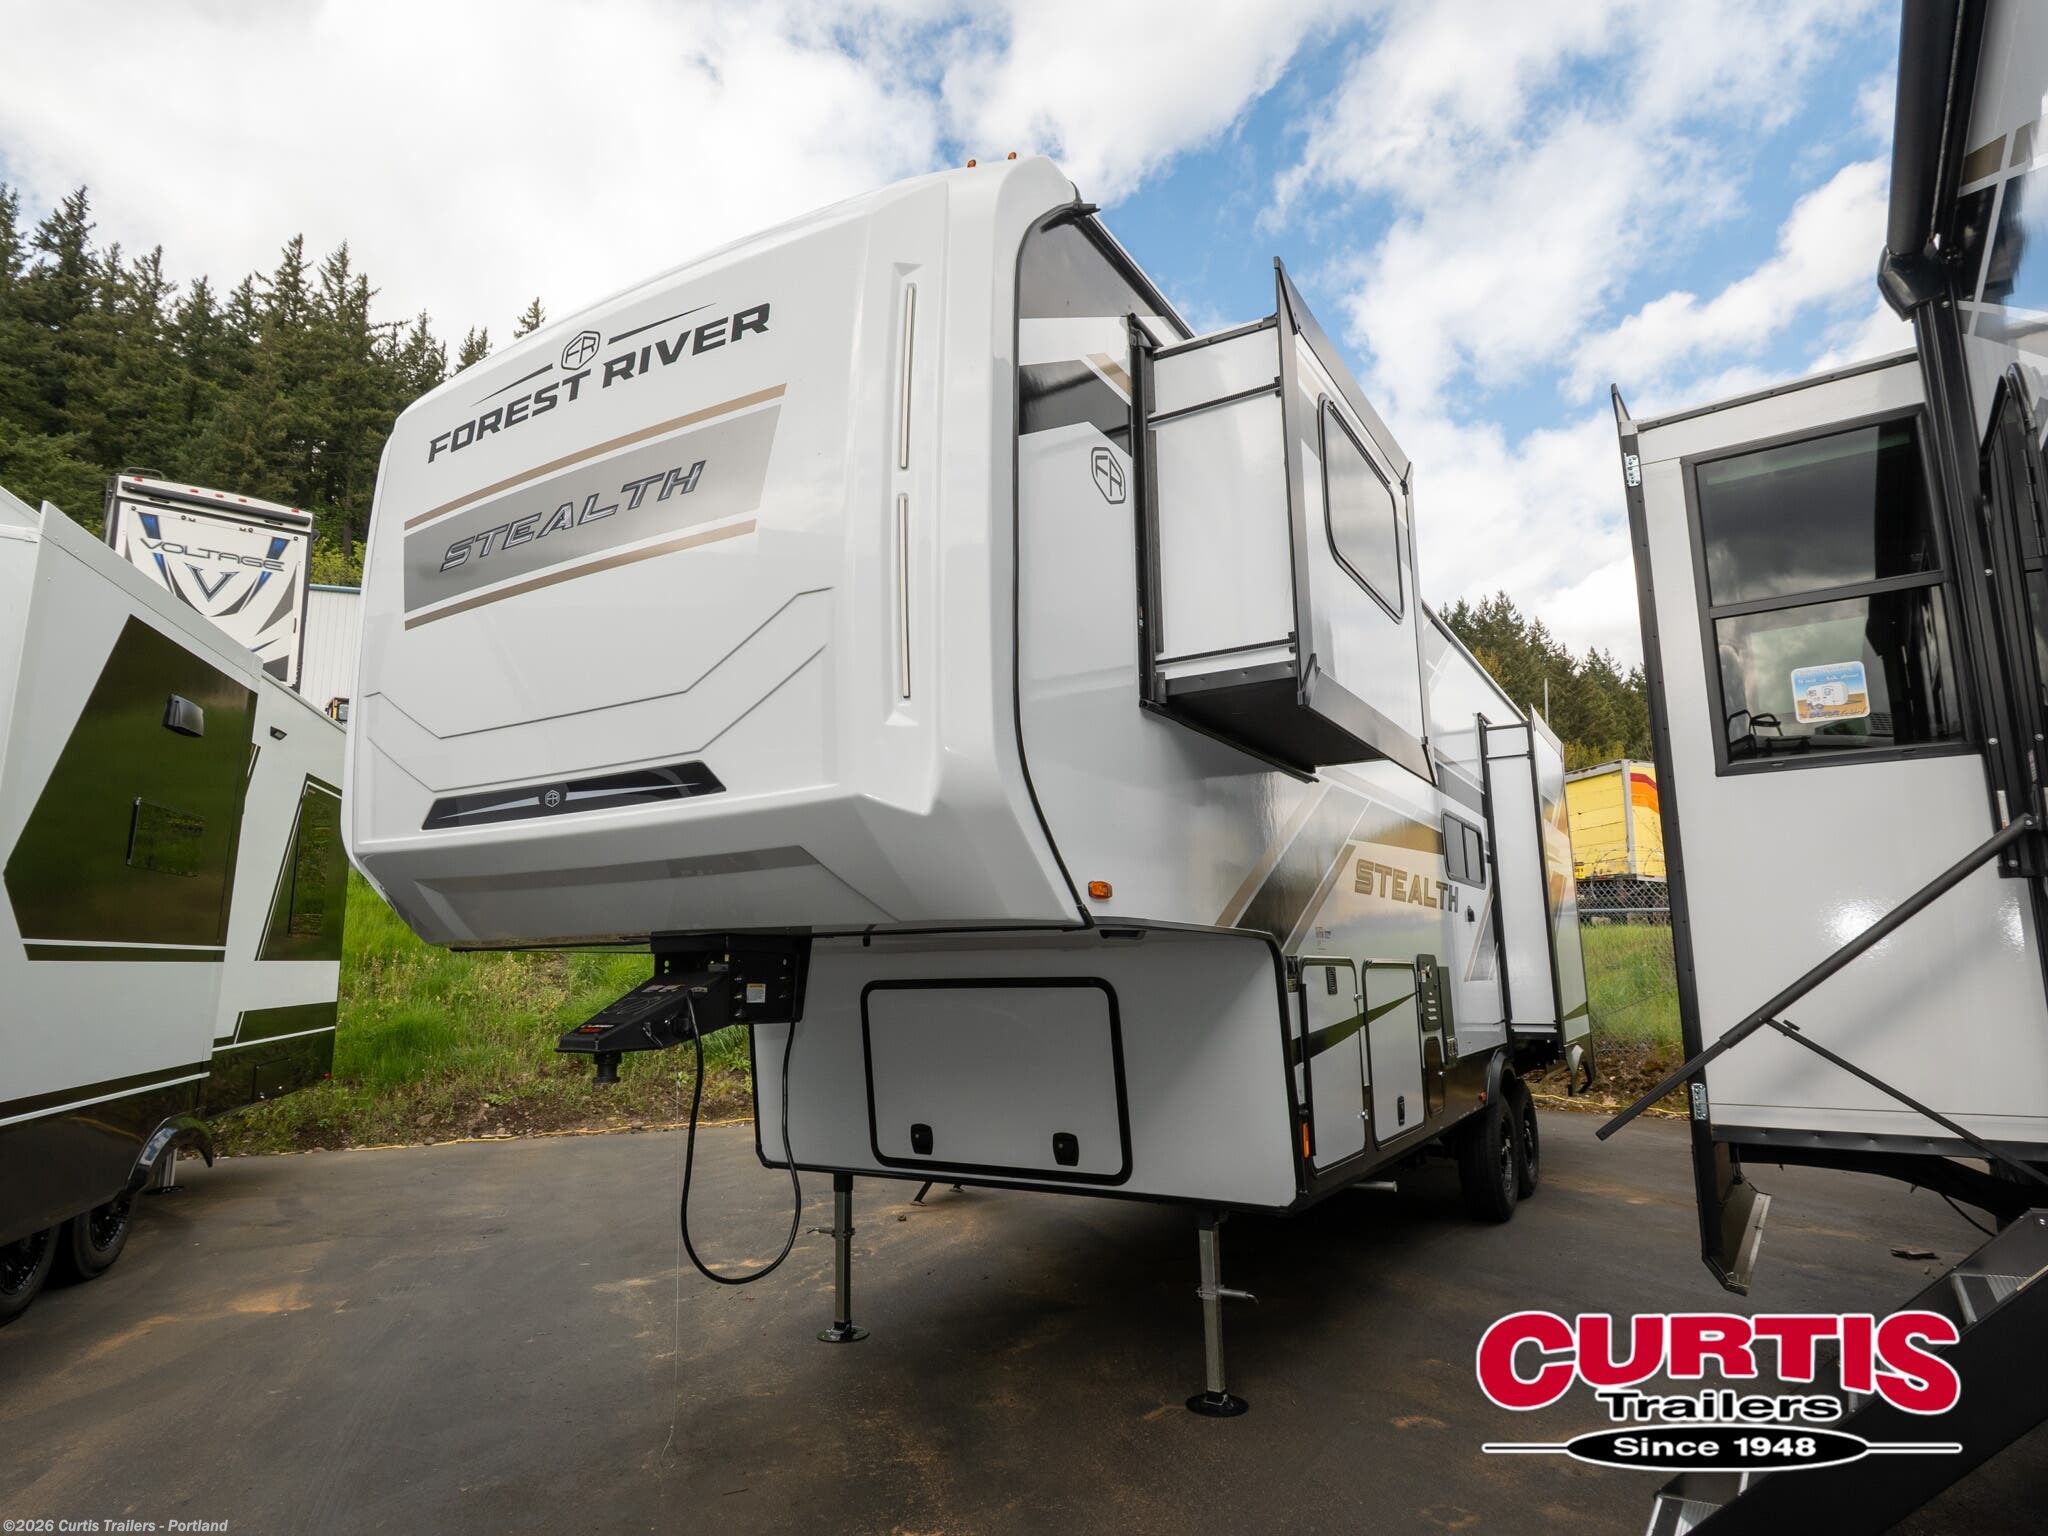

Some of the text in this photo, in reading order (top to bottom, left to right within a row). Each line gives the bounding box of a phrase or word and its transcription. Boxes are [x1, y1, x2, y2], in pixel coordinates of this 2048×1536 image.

[428, 303, 770, 464] FOREST RIVER
[140, 538, 285, 572] VOLTAGE
[439, 459, 706, 573] STEALTH
[1354, 858, 1459, 913] STEALTH
